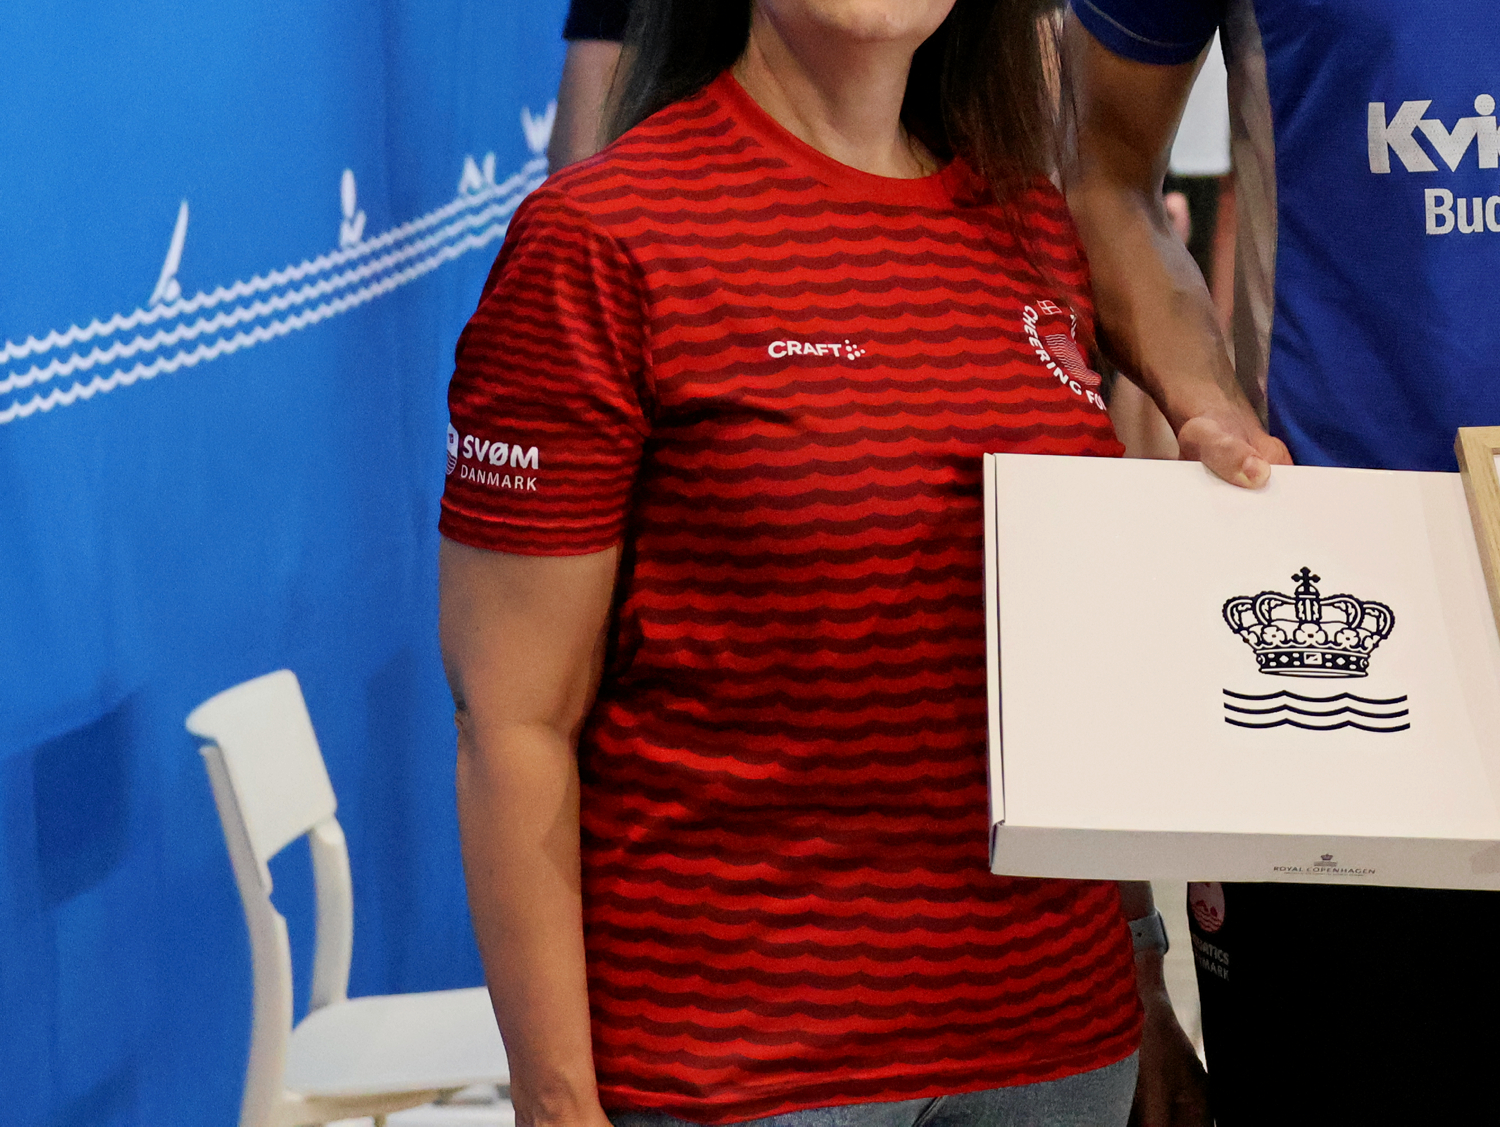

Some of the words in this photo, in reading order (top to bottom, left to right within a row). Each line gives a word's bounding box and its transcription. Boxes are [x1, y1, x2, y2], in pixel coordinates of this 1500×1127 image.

[767, 340, 842, 359] CRAFT
[1022, 305, 1083, 396] CHEERING
[462, 434, 540, 470] SVØM
[460, 464, 538, 491] DANMARK
[1306, 866, 1376, 875] COPENHAGEN
